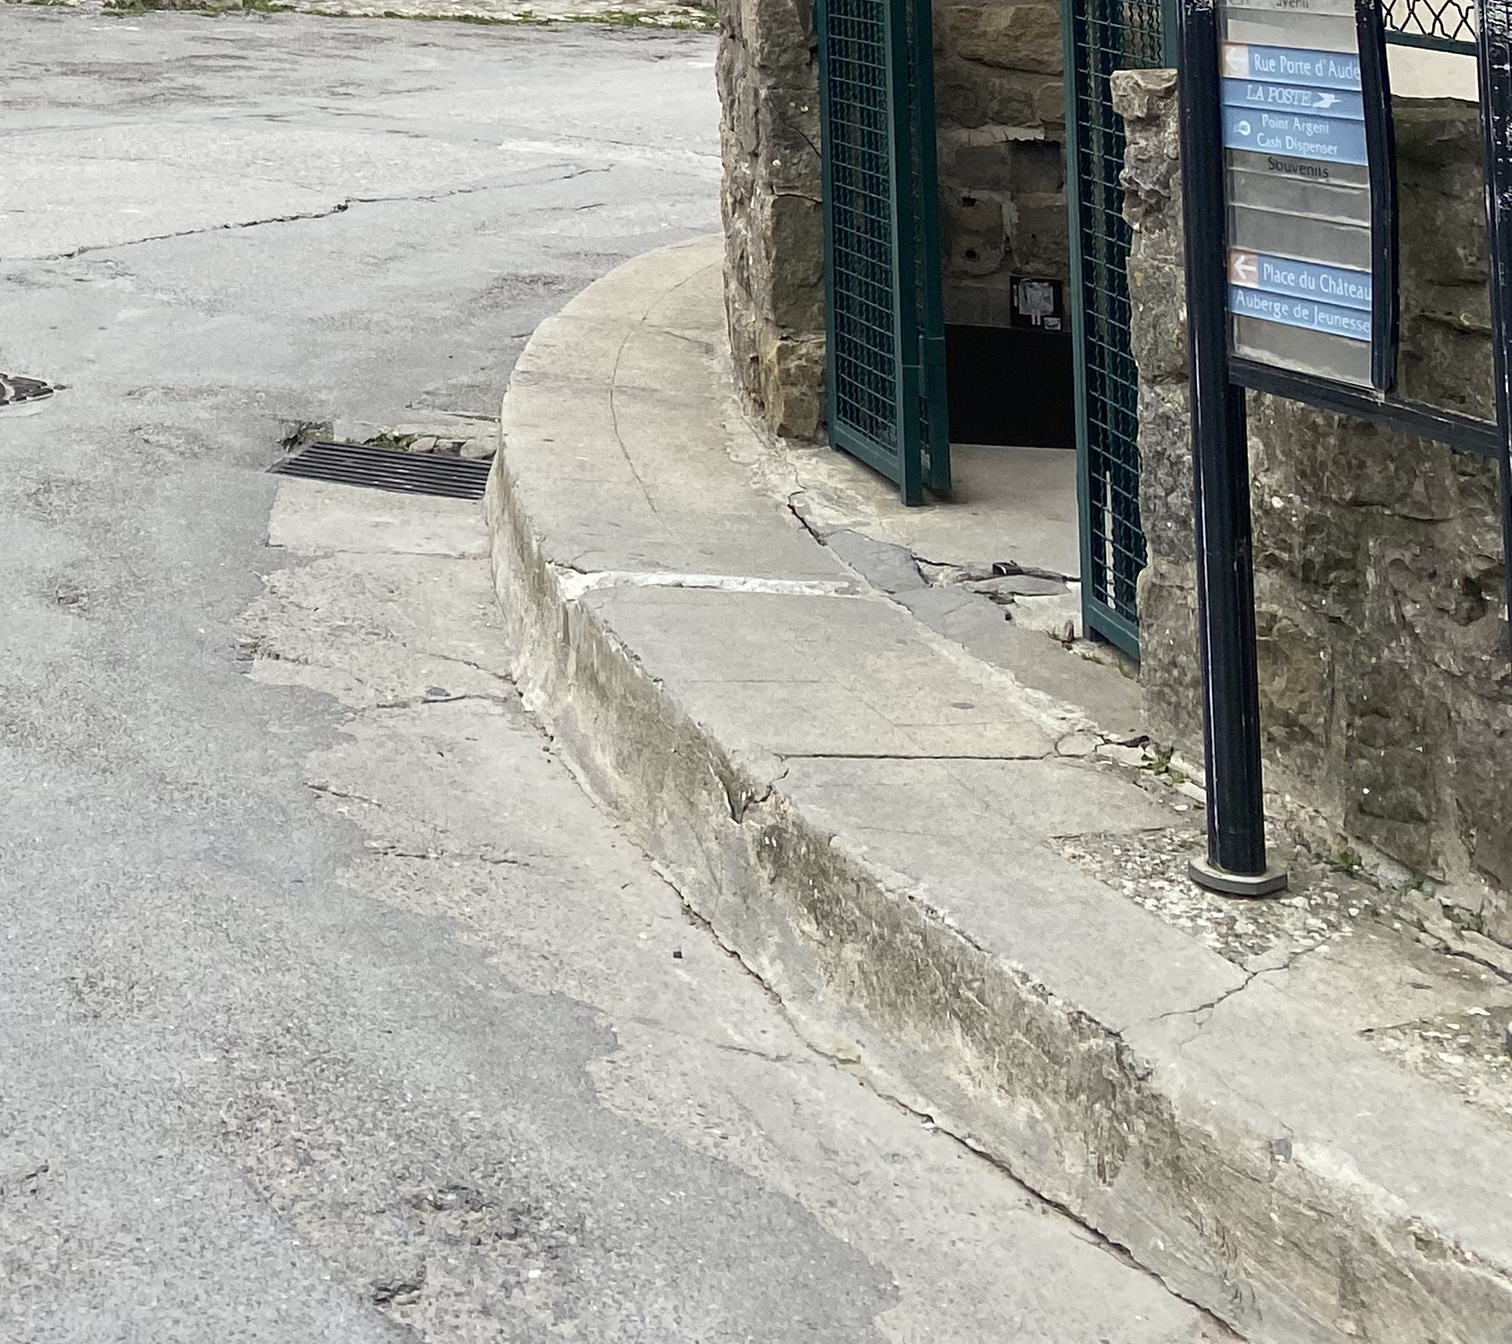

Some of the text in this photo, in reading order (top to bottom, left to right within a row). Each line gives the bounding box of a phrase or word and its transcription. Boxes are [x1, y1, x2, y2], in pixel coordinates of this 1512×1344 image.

[1254, 53, 1360, 79] Rue Porte d'Aude
[1246, 84, 1312, 106] LA POSTE
[1261, 114, 1330, 136] Point Argent
[1256, 132, 1338, 155] Cash Dispenser
[1263, 263, 1370, 301] Place du Château
[1236, 290, 1370, 333] Auberge de Jeunesse
